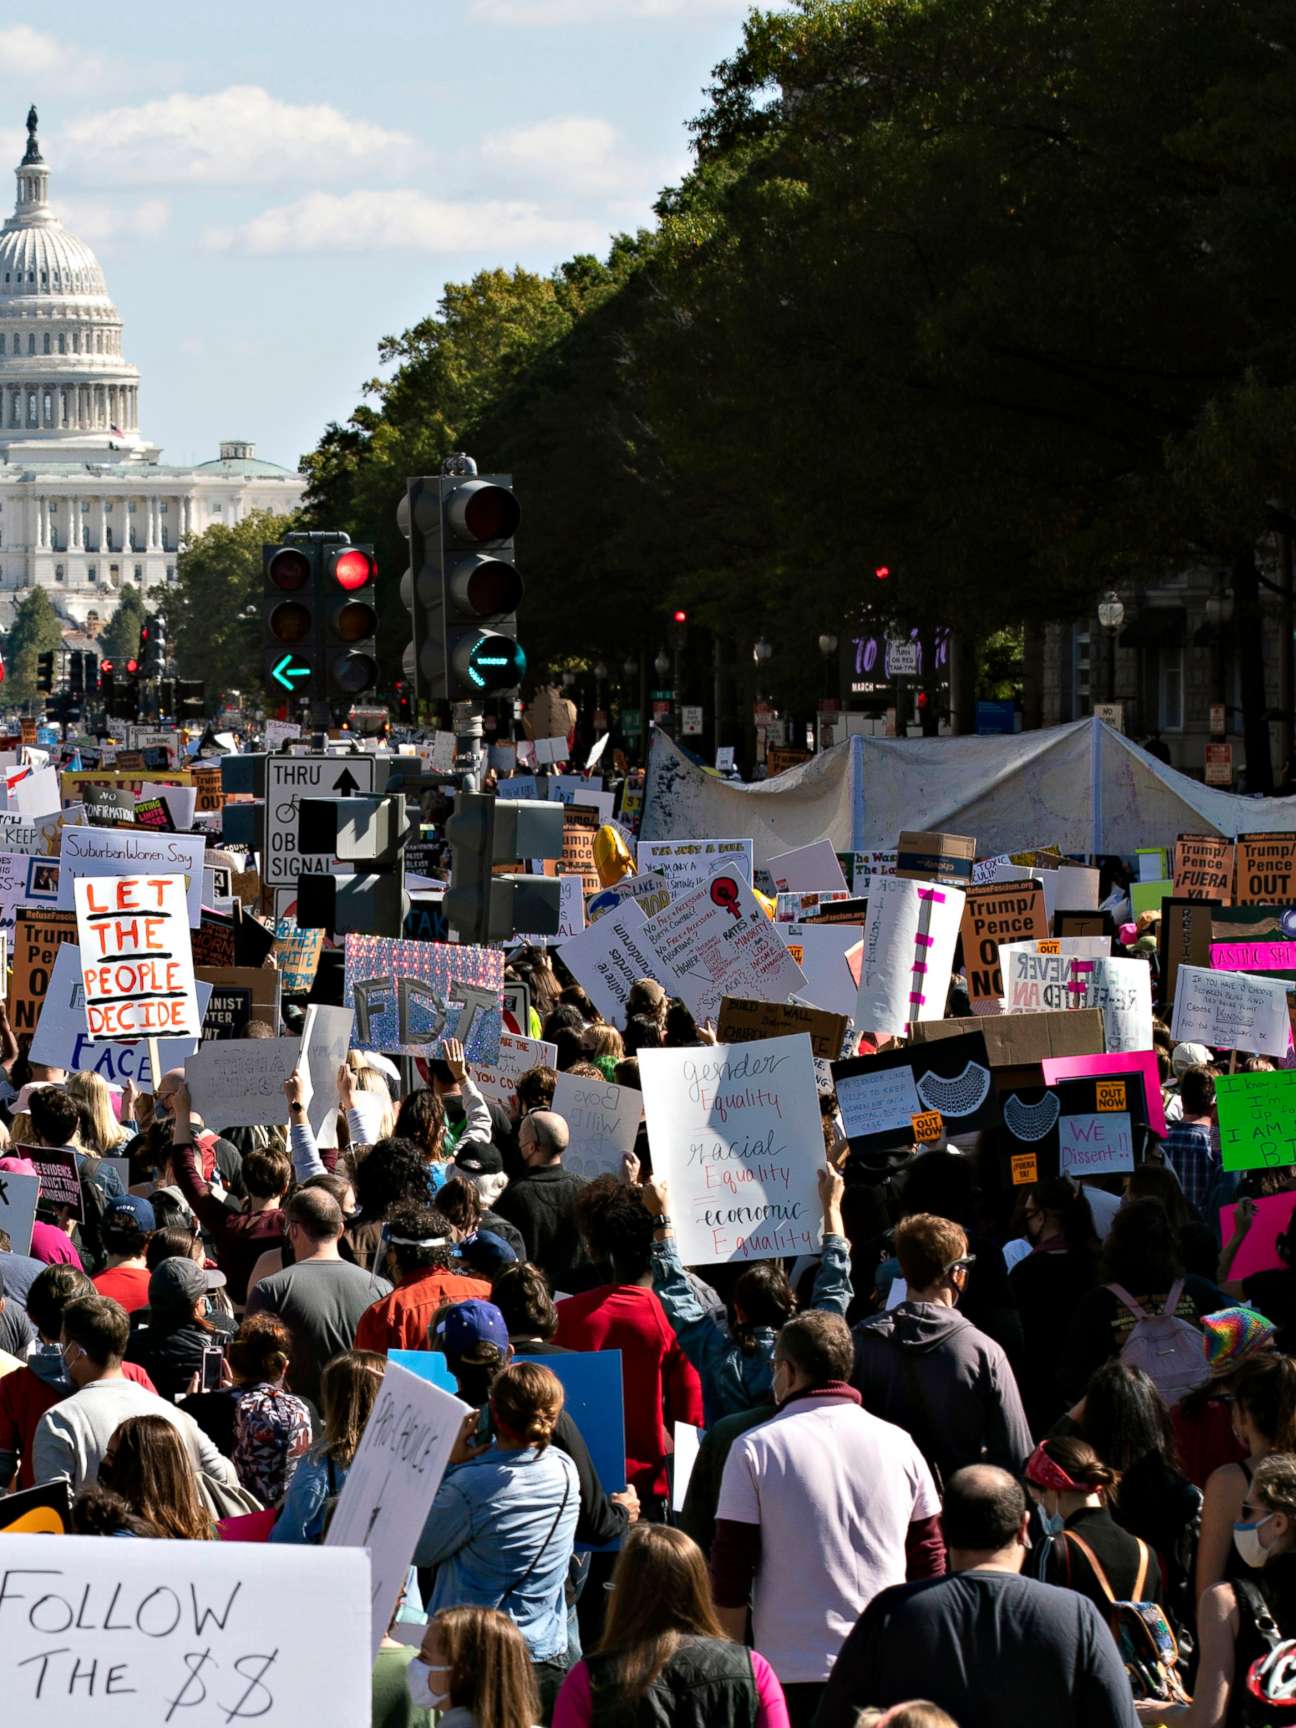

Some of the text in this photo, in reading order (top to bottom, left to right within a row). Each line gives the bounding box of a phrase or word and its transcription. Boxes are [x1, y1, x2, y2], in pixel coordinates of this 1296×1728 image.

[852, 683, 874, 692] MARCH
[273, 765, 322, 785] THRU
[100, 792, 116, 801] NO
[84, 803, 135, 822] CONFIRMATION
[5, 829, 37, 844] KEEP
[272, 832, 295, 851] OB
[66, 834, 193, 869] Suburban Women Say
[1179, 843, 1226, 857] Trump/
[1244, 844, 1296, 858] Trump/
[1182, 855, 1223, 869] Pence
[1247, 859, 1292, 872] Pence
[632, 880, 654, 895] LAKE
[1176, 871, 1228, 888] ¡FUERA
[1249, 874, 1291, 895] OUT
[86, 880, 173, 913] LET
[967, 894, 1036, 917] Trump/
[89, 918, 165, 954] THE
[723, 920, 747, 941] RATES
[974, 917, 1034, 936] Pence
[1040, 944, 1059, 954] OUT
[83, 961, 184, 996] PEOPLE
[87, 1000, 187, 1034] DECIDE
[354, 975, 500, 1046] FDT
[683, 1053, 791, 1103] gender
[1099, 1097, 1125, 1108] NOW
[1100, 1088, 1123, 1098] OUT
[1247, 1096, 1281, 1108] I'm
[701, 1087, 782, 1122] Equality
[916, 1117, 938, 1129] OUT
[917, 1126, 942, 1139] NOW
[1070, 1119, 1105, 1142] WE
[1225, 1125, 1282, 1143] I AM
[687, 1129, 787, 1167] racial
[42, 1161, 73, 1179] EVIDENCE
[705, 1163, 790, 1194] Equality
[696, 1200, 809, 1226] economic
[712, 1228, 812, 1256] Equality
[17, 1647, 279, 1725] THE $$
